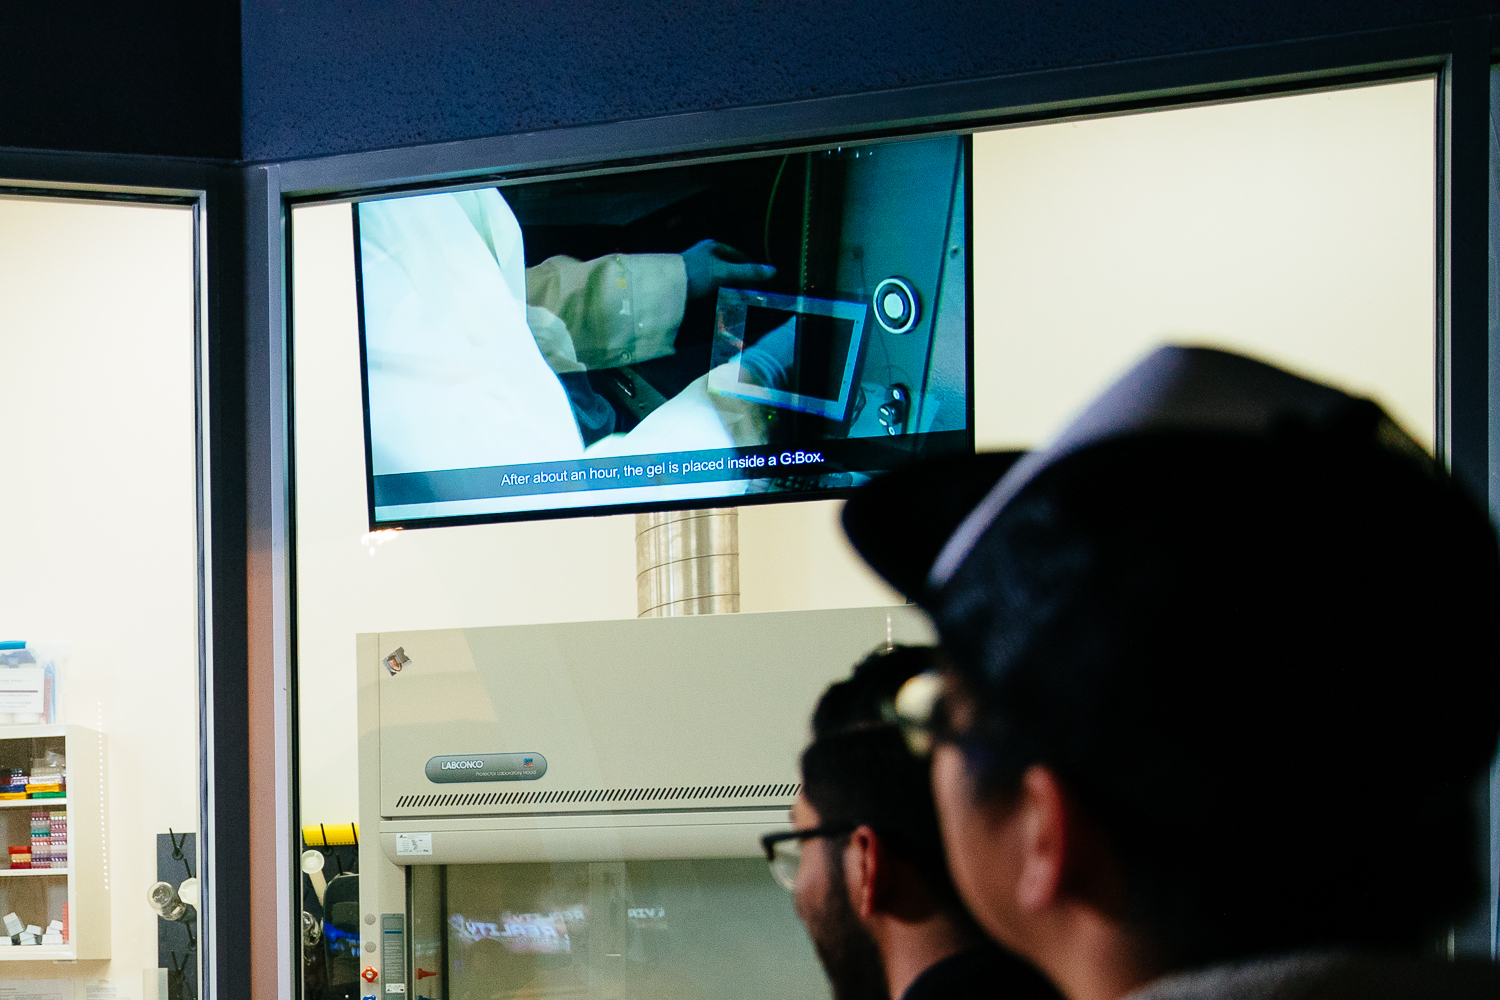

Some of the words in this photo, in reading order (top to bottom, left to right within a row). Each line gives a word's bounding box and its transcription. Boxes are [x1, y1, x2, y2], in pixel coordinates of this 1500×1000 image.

[500, 474, 529, 486] After
[533, 471, 568, 483] about
[570, 471, 586, 480] an
[590, 467, 620, 480] hour,
[623, 465, 643, 477] the
[646, 462, 666, 477] gel
[669, 461, 679, 473] is
[682, 460, 724, 475] placed
[727, 455, 764, 469] inside
[768, 457, 777, 466] a
[780, 451, 824, 465] G:Box.
[442, 761, 483, 769] LABCONCO
